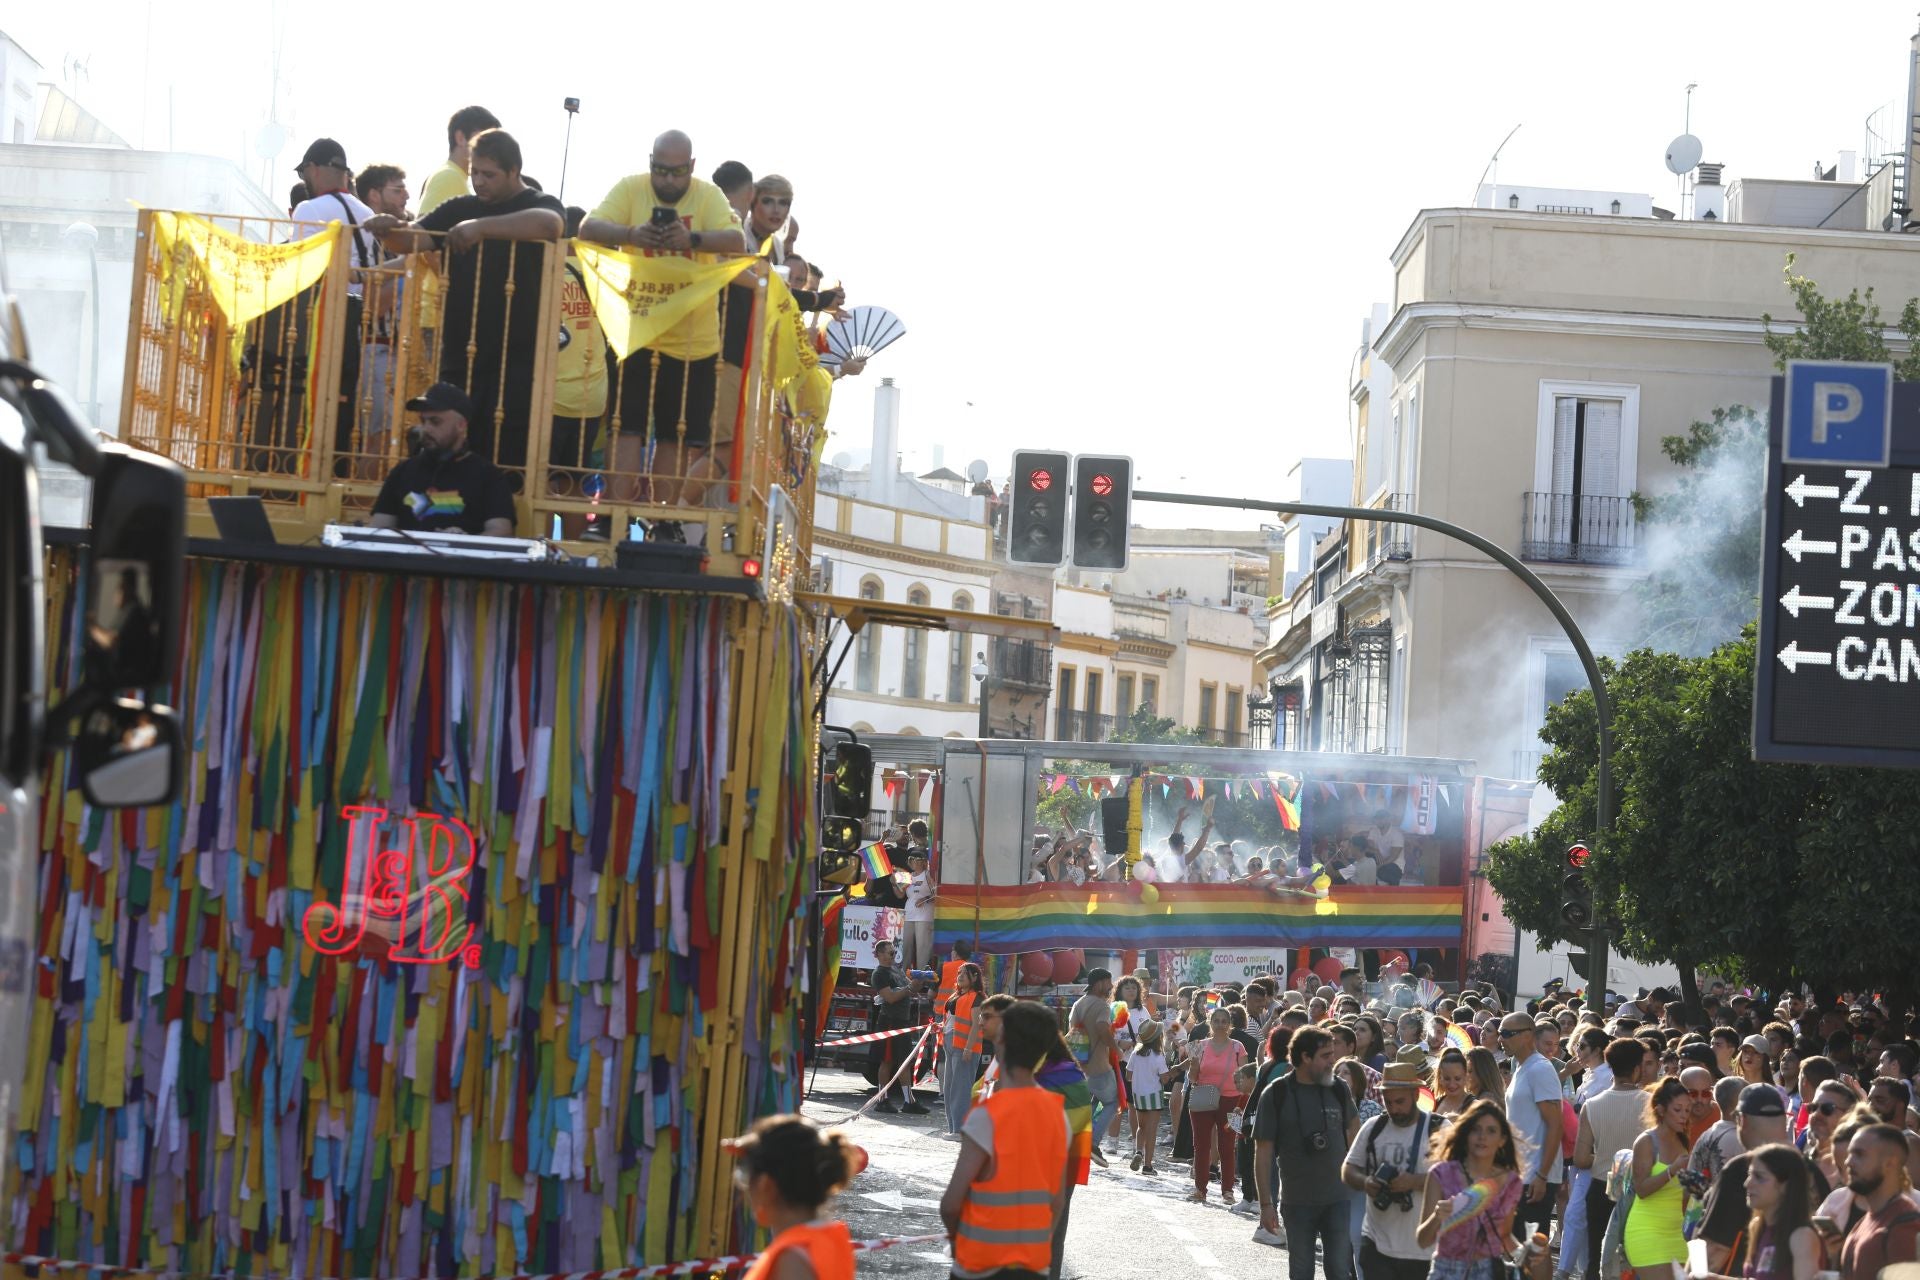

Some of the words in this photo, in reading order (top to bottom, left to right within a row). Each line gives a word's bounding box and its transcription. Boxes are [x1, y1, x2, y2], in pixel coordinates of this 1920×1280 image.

[562, 302, 590, 316] PUEB
[1812, 382, 1863, 443] P
[1840, 470, 1888, 514] Z.
